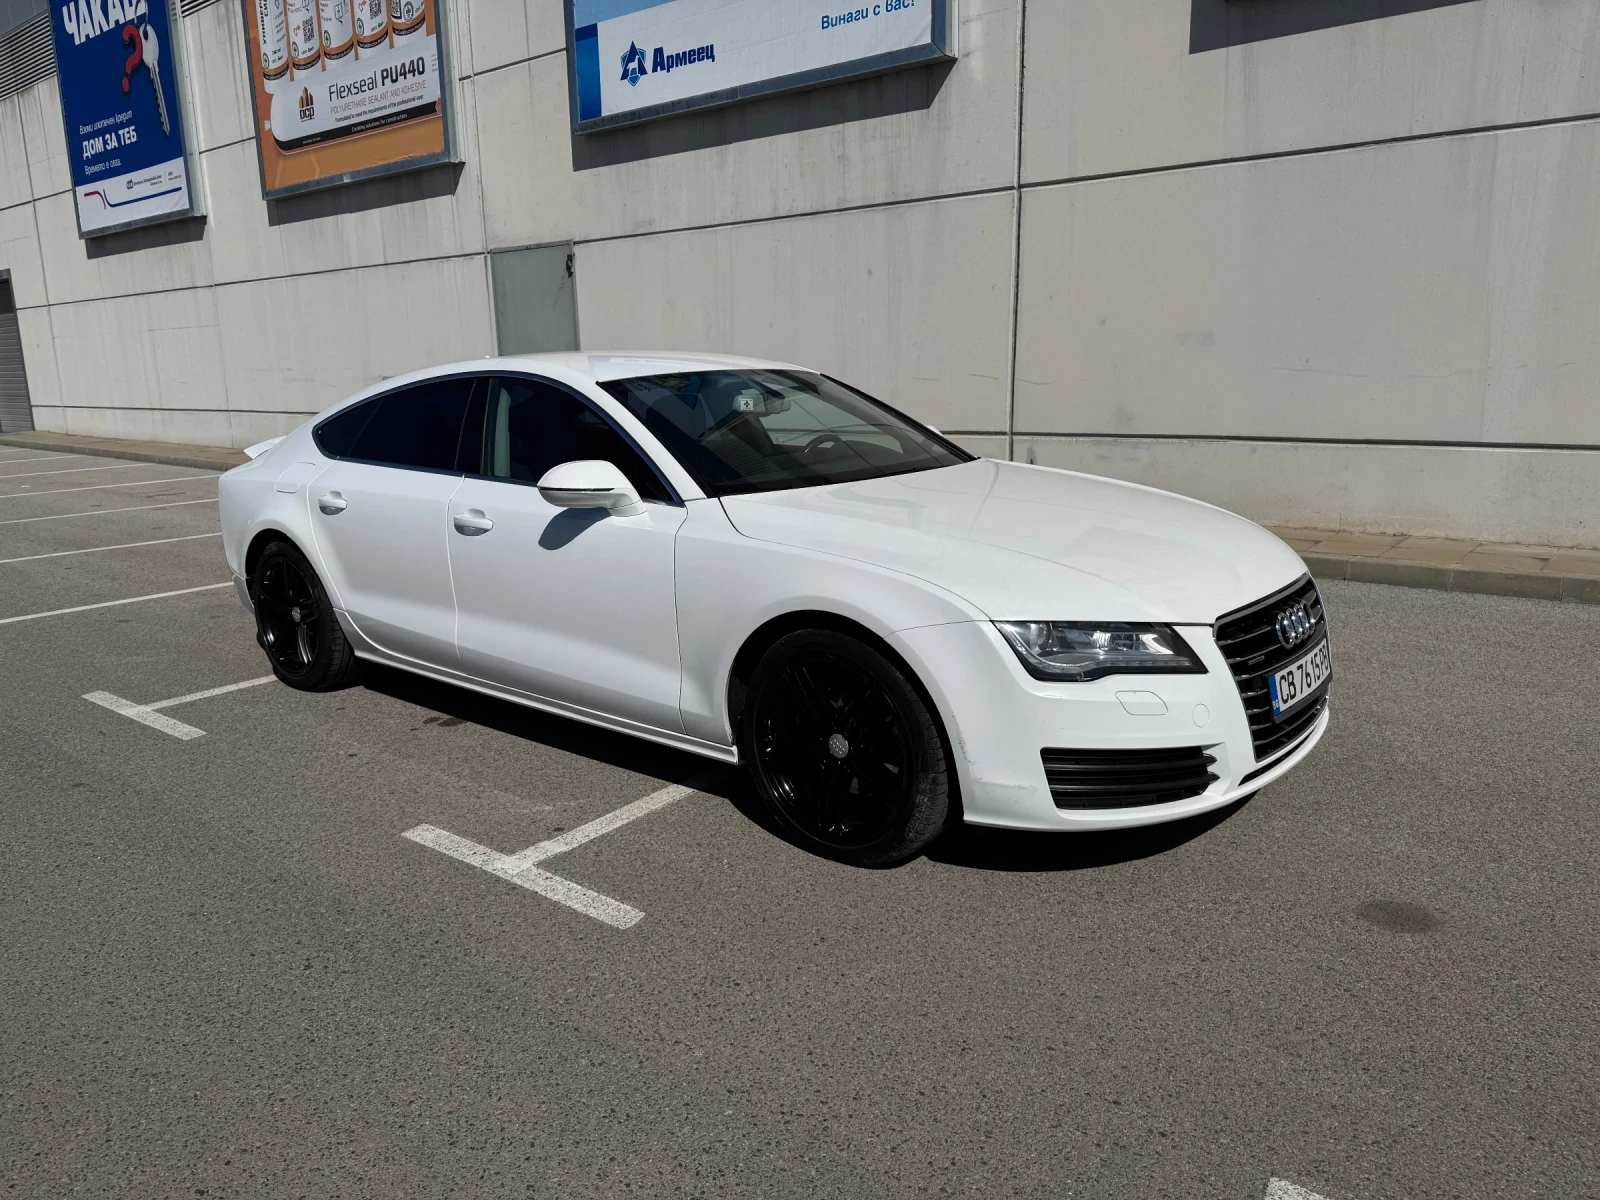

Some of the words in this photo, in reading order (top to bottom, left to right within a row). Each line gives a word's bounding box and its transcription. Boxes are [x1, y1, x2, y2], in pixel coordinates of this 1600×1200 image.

[821, 7, 868, 30] Винаги
[873, 4, 881, 16] с
[651, 43, 715, 73] Армеец
[328, 70, 378, 102] Flexseal
[380, 56, 426, 87] PU440
[330, 97, 367, 115] POLYURETHANE
[367, 90, 390, 105] SEALANT
[390, 87, 401, 99] AND
[401, 79, 427, 96] ADHESIVE
[82, 136, 104, 161] ДОМ
[105, 132, 119, 151] ЗА
[1279, 670, 1296, 704] CB
[1296, 652, 1320, 694] 7615
